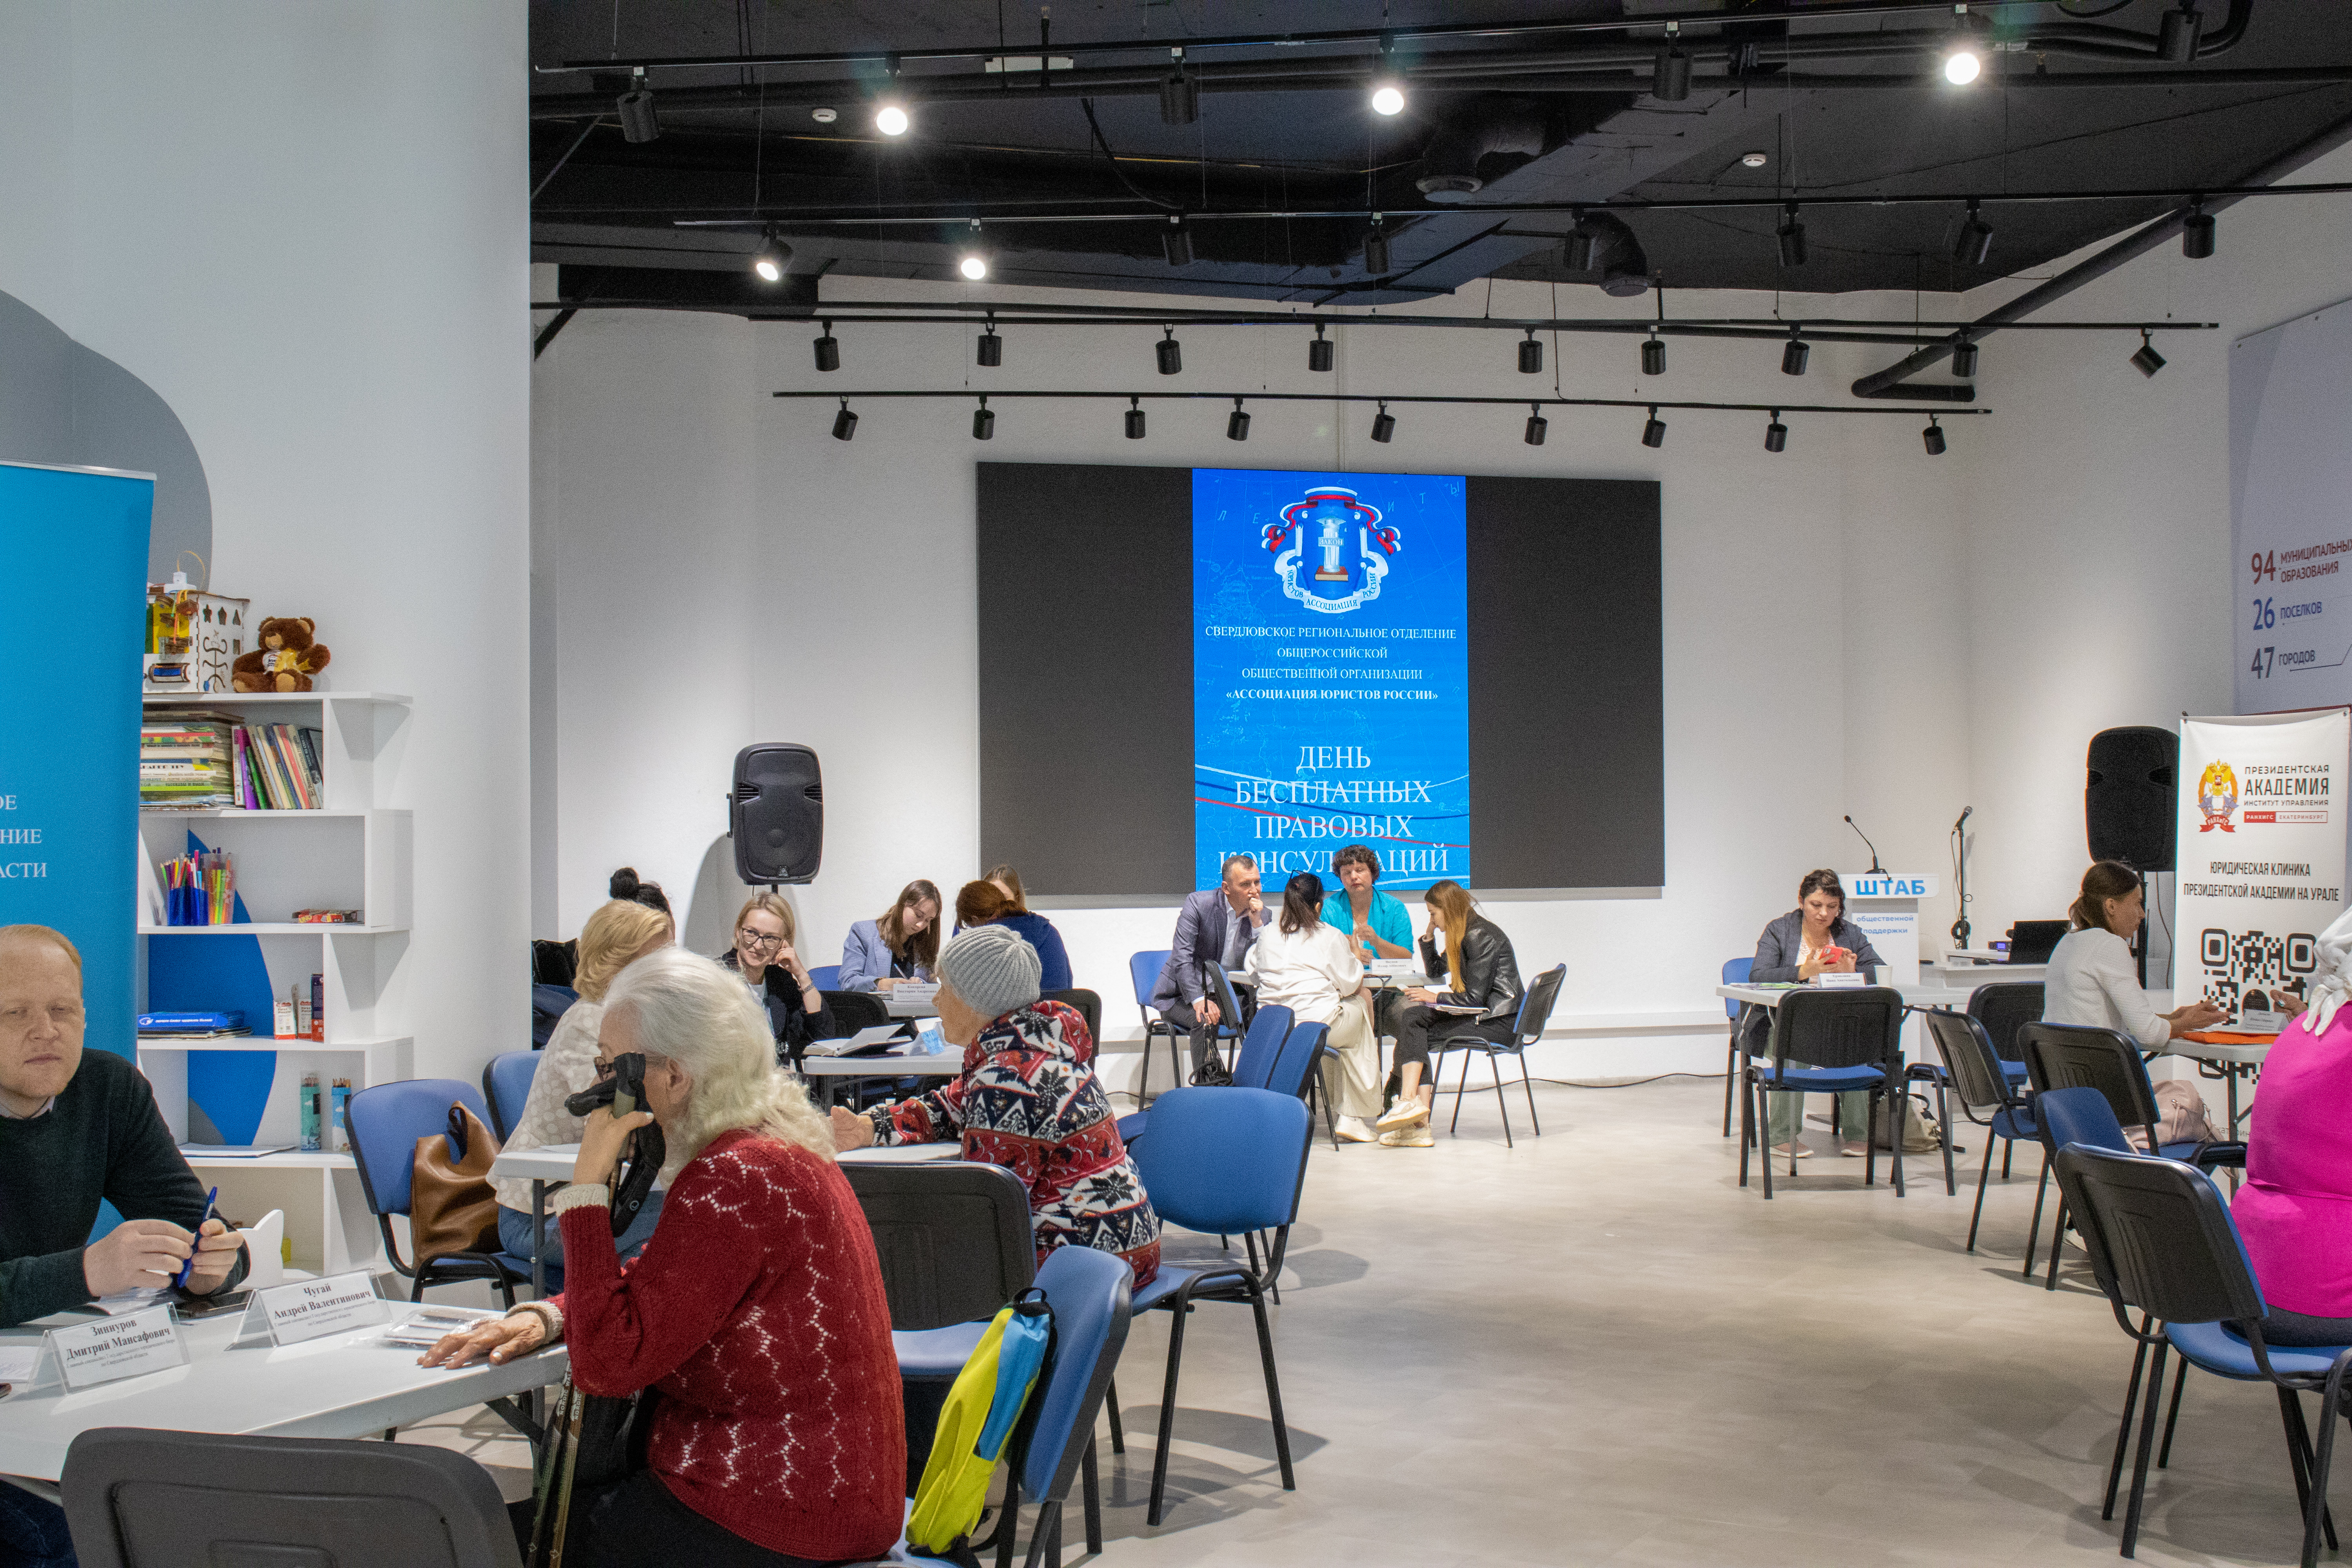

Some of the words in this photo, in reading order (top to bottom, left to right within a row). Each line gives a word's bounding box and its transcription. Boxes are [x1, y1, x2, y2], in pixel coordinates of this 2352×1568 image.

[2251, 550, 2276, 585] 94
[2281, 561, 2339, 583] ОБРАЗОВАНИЯ
[1287, 569, 1303, 598] ЮРИСТОВ
[1306, 599, 1358, 611] АССОЦИАЦИЯ
[1362, 573, 1376, 598] РОССИИ
[2253, 597, 2275, 631] 26
[2280, 601, 2322, 619] ПОСЕЛКОВ
[1205, 626, 1295, 639] СВЕРДЛОВСКОЕ
[1299, 627, 1388, 639] РЕГИОНАЛЬНОЕ
[1391, 628, 1456, 639] ОТДЕЛЕНИЕ
[1278, 646, 1388, 660] ОБЩЕРОССИЙСКОЙ
[2251, 646, 2275, 679] 47
[2279, 650, 2316, 666] ГОРОДОВ
[1242, 667, 1337, 680] ОБЩЕСТВЕННОЙ
[1340, 669, 1422, 681] ОРГАНИЗАЦИИ
[1226, 689, 1317, 702] «АССОЦИАЦИЯ
[1320, 690, 1380, 700] ЮРИСТОВ
[1384, 690, 1437, 701] РОССИИ»
[1296, 746, 1371, 774] ДЕНЬ
[2245, 764, 2329, 775] ПРЕЗИДЕНТСКАЯ
[1236, 780, 1432, 804] БЕСПЛАТНЫХ
[2245, 778, 2329, 796] АКАДЕМИЯ
[1254, 815, 1414, 839] ПРАВОВЫХ
[1218, 842, 1448, 877] КНСУЛАЦИЙ
[2210, 861, 2269, 875] ЮРИДИЧЕСКАЯ
[2272, 863, 2310, 876] КЛИНИКА
[1855, 879, 1926, 896] ШТАБ
[2183, 883, 2248, 897] ПРЕЗИДЕНТСКОЙ
[2250, 886, 2296, 900] АКАДЕМИИ
[2297, 887, 2308, 900] НА
[2310, 888, 2339, 901] УРАЛЕ
[303, 1283, 332, 1298] Чугай
[274, 1304, 308, 1319] Андрей
[308, 1291, 371, 1310] Валентинович
[91, 1320, 137, 1336] Зиннуров
[67, 1340, 111, 1361] Дмитрий
[112, 1328, 170, 1348] Мансафович
